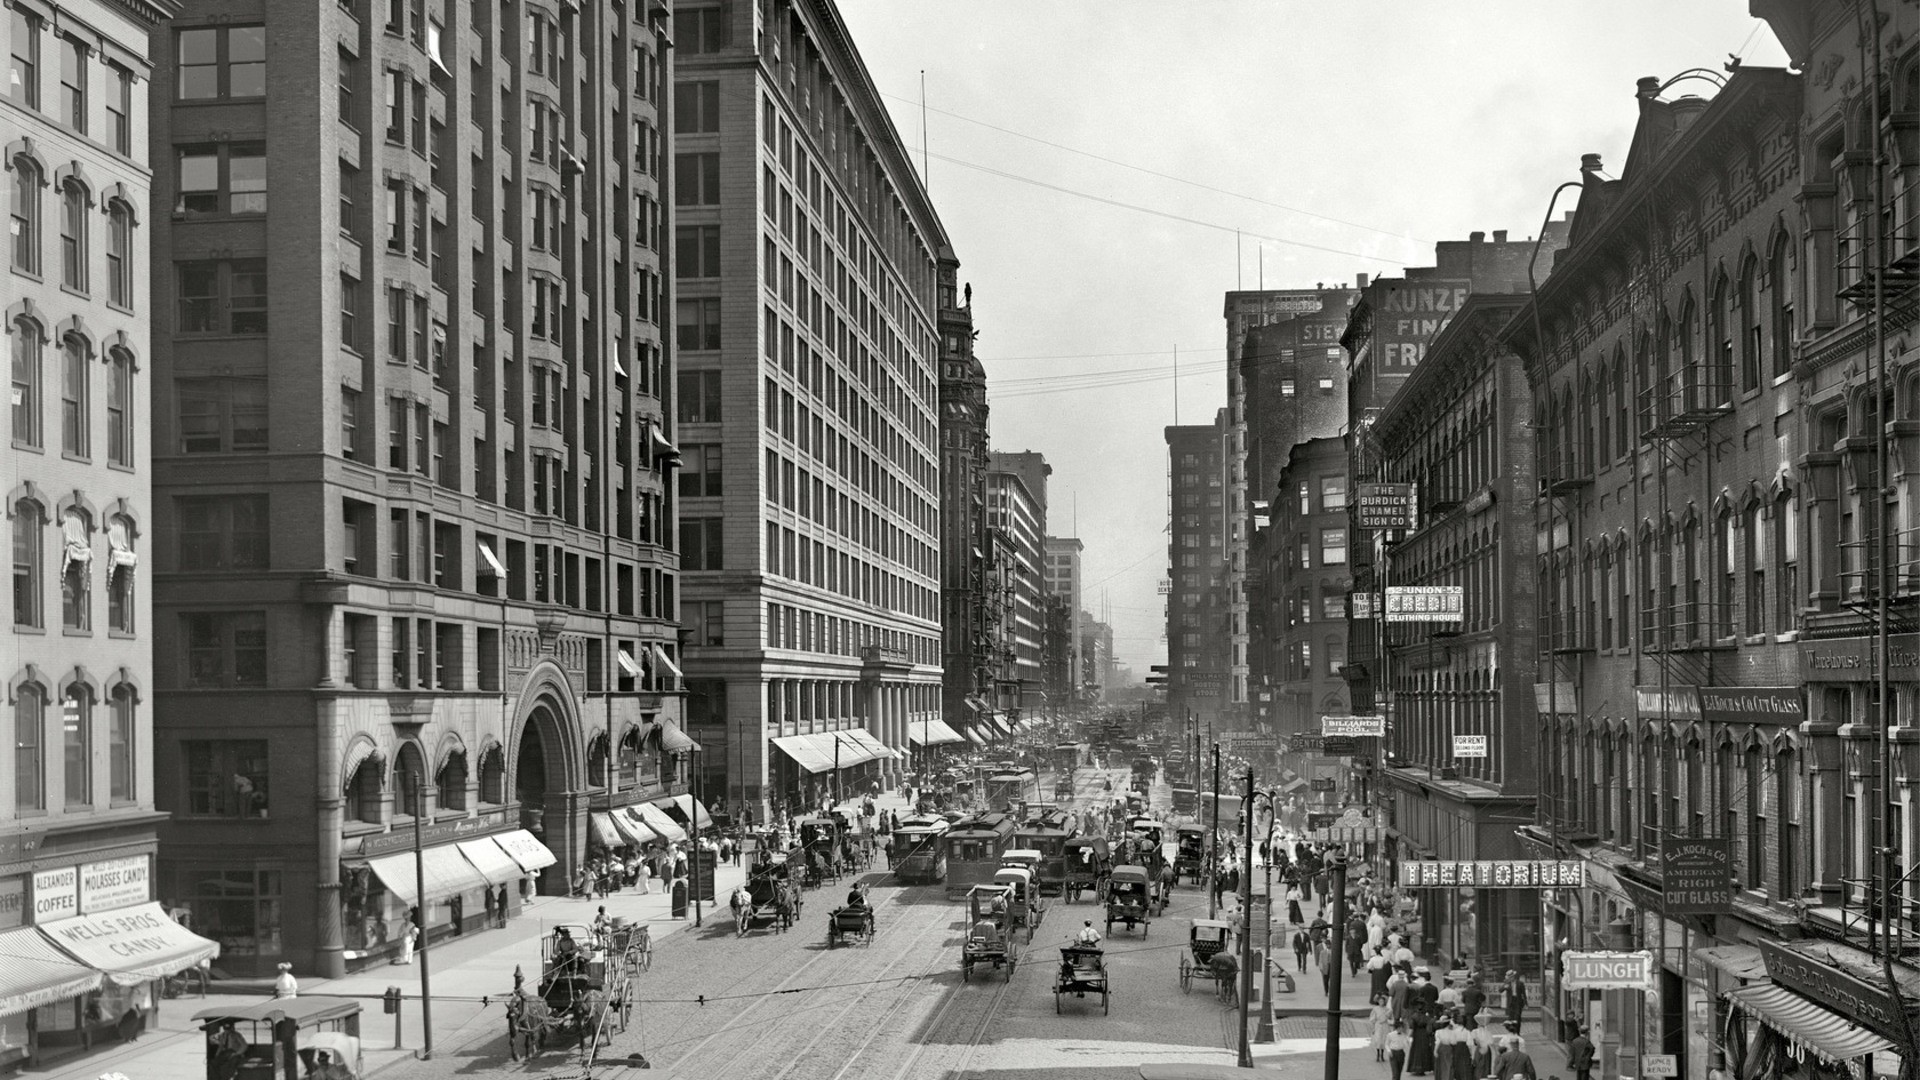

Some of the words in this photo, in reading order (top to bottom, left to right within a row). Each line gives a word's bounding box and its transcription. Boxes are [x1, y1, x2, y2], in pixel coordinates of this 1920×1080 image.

[1384, 288, 1466, 312] KUNZE
[1374, 486, 1394, 495] THE
[1361, 496, 1407, 505] BURDICK
[1362, 507, 1405, 516] ENAMEL
[1363, 517, 1388, 526] SIGN
[1388, 614, 1430, 622] CLOTHING
[1432, 614, 1461, 622] HOUSE
[1806, 649, 1860, 669] Warehouse
[1454, 736, 1467, 745] FOR
[1468, 736, 1484, 745] RENT
[36, 871, 75, 891] ALEXANDER
[85, 871, 121, 892] MOLASSES
[1405, 864, 1580, 885] THEATORIUM
[37, 894, 75, 914] COFFEE
[1667, 891, 1687, 904] CUT
[59, 919, 119, 943] WELLS
